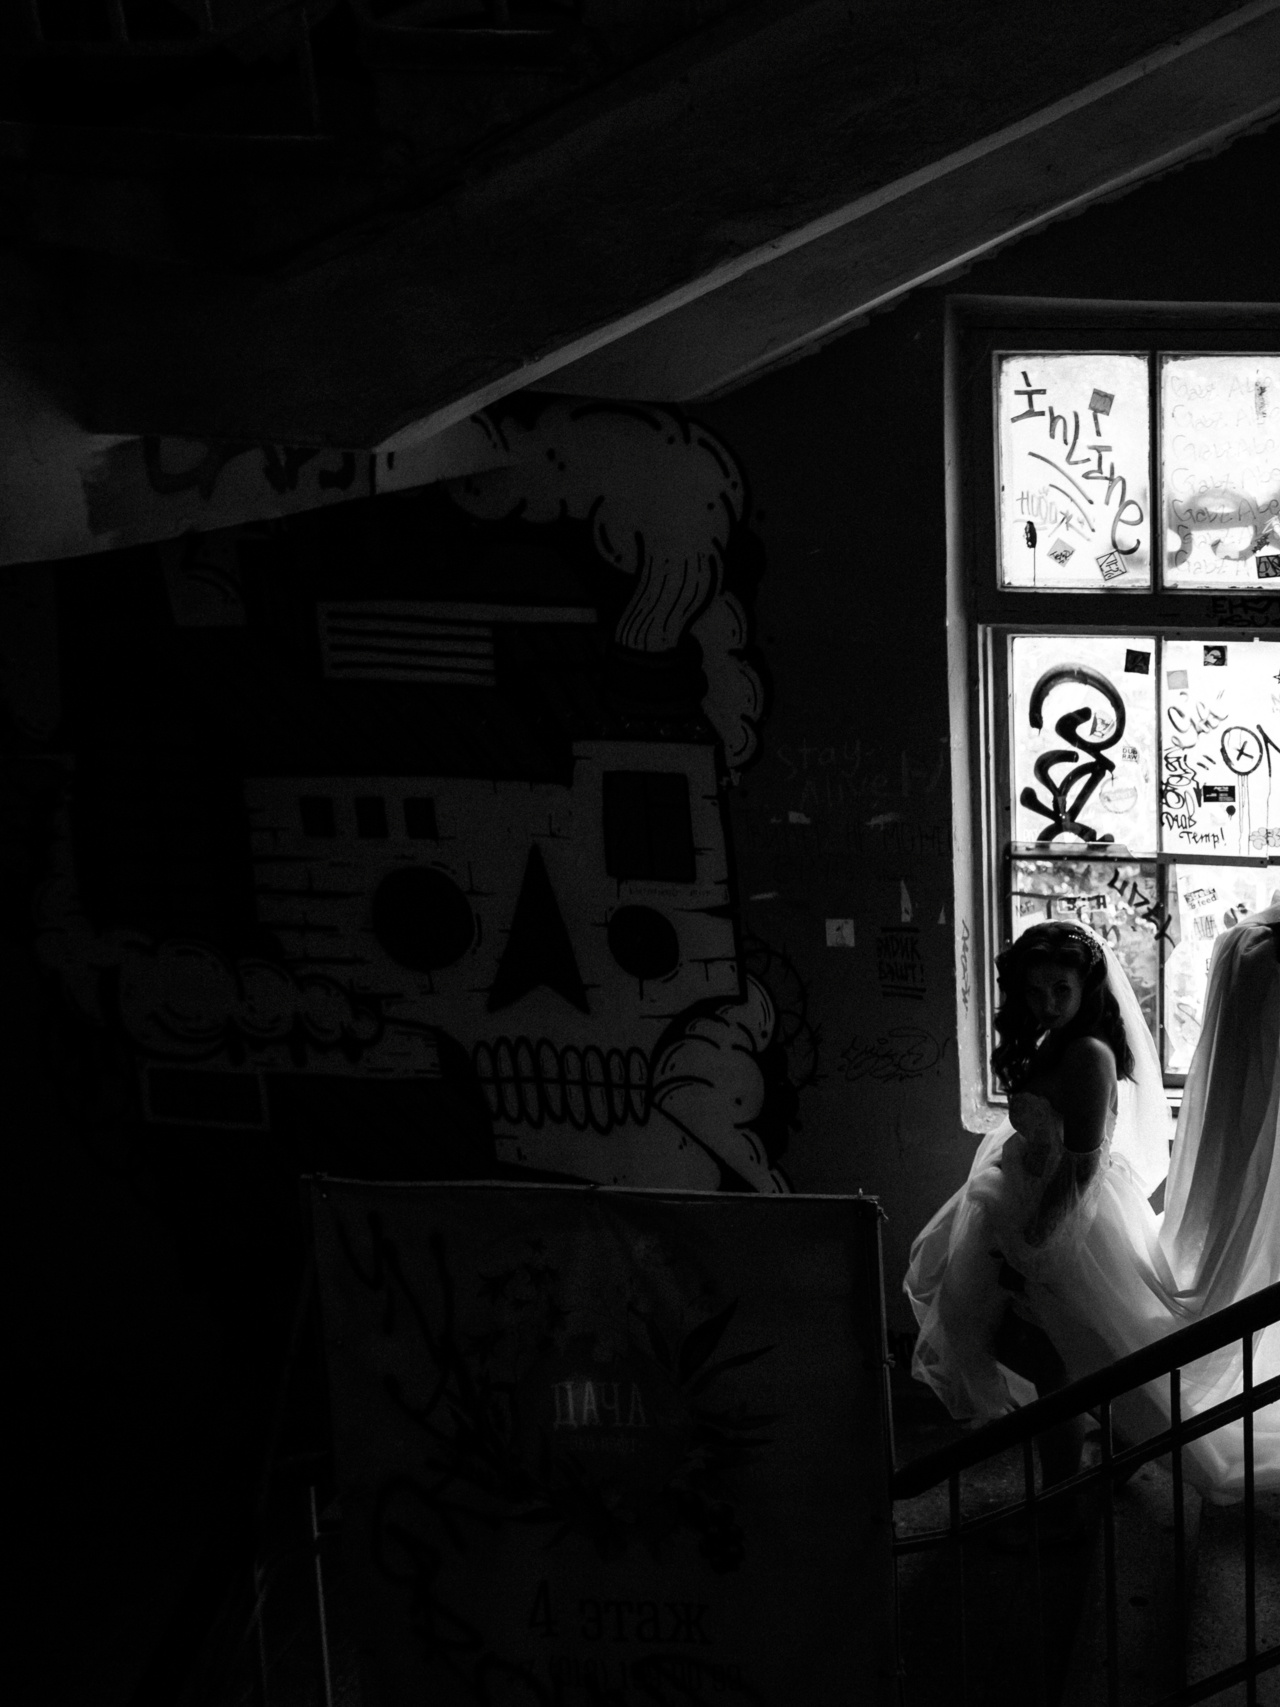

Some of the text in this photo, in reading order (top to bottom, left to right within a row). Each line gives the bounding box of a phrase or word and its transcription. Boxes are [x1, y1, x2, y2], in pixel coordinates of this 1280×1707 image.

[550, 1380, 651, 1431] ДАЧА
[528, 1580, 713, 1645] 4 этаж
